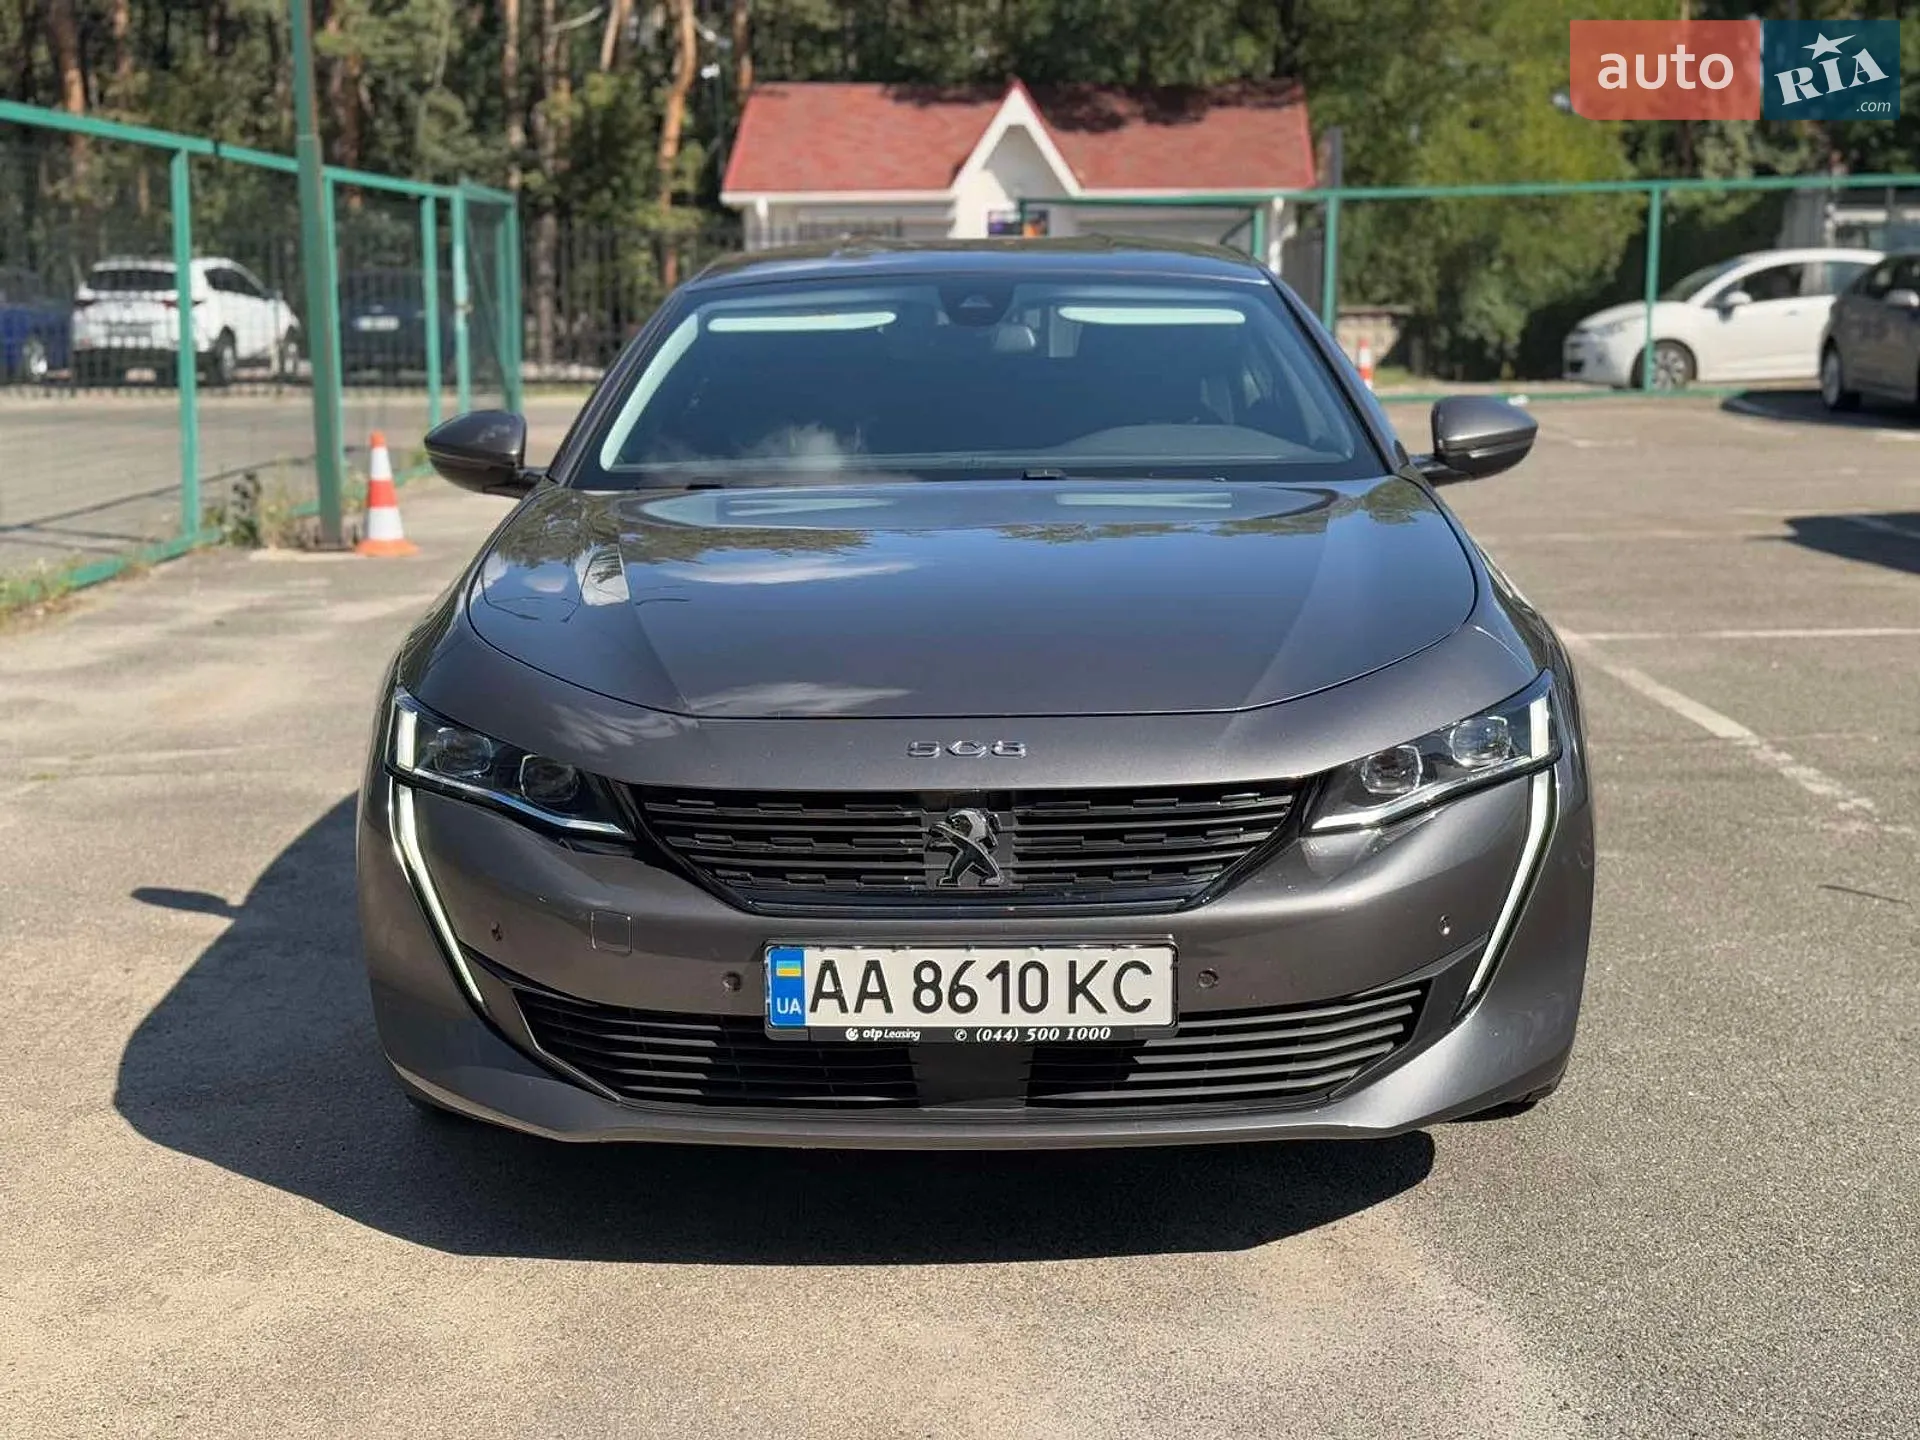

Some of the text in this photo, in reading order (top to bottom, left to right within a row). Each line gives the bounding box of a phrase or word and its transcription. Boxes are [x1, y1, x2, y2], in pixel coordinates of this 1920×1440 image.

[809, 960, 1152, 1015] AA 8610 KC
[777, 998, 803, 1015] UA
[862, 1029, 921, 1042] otp Leasing
[975, 1027, 1111, 1042] (044) 500 1000
